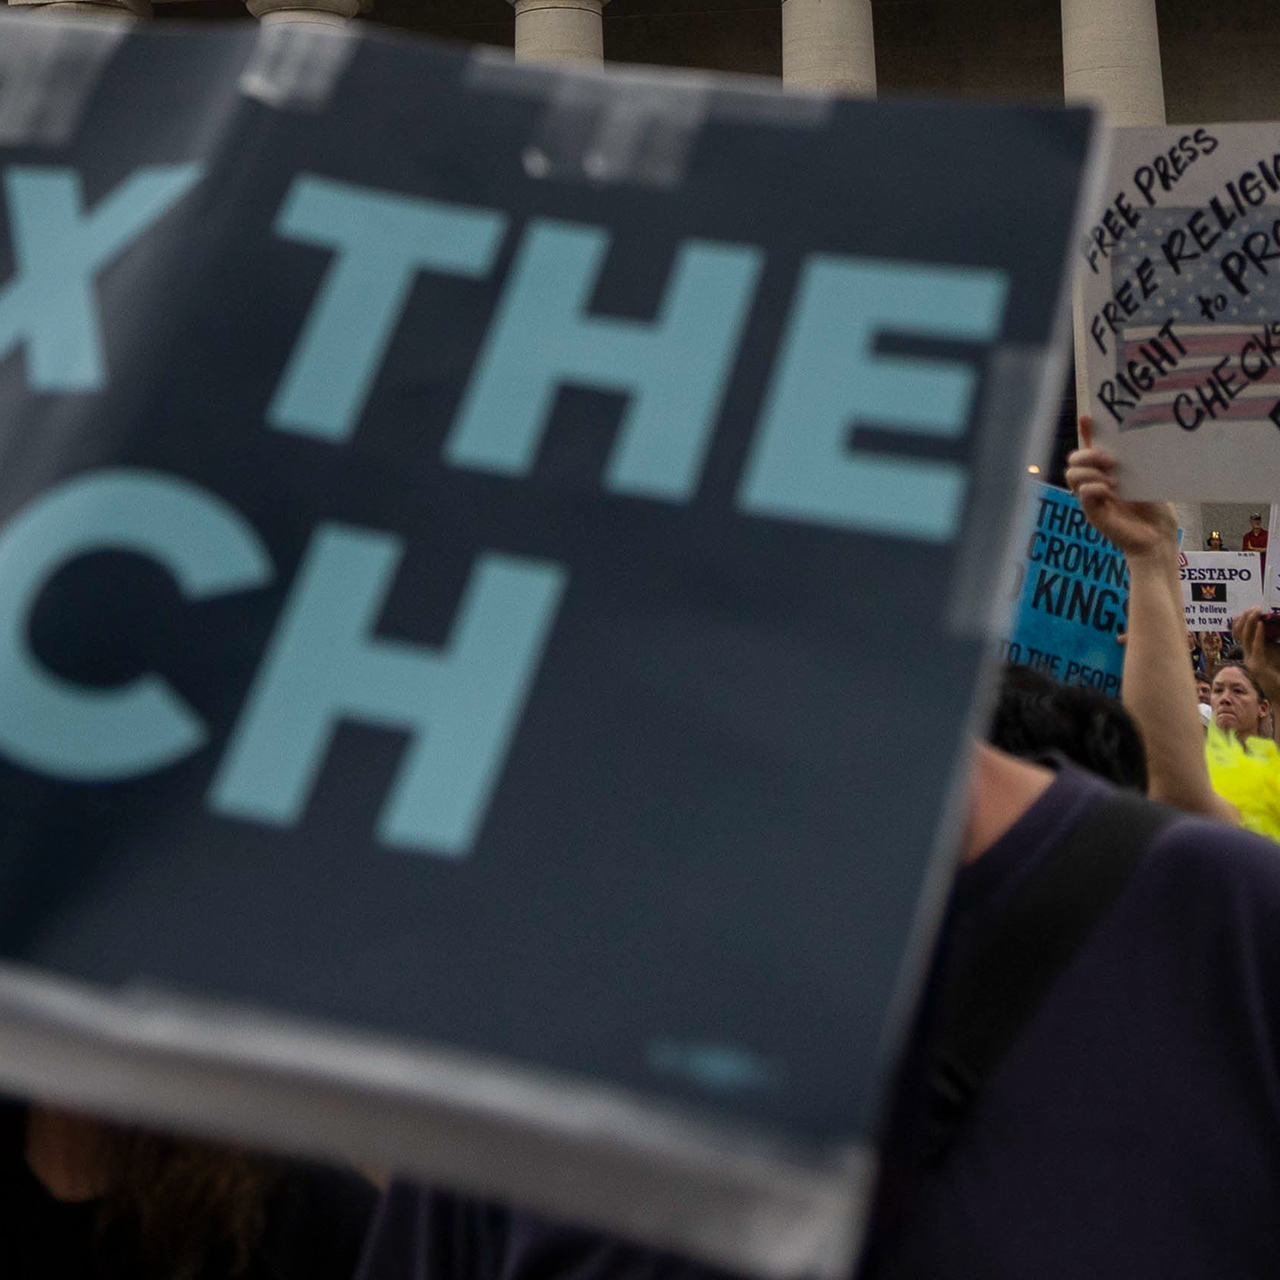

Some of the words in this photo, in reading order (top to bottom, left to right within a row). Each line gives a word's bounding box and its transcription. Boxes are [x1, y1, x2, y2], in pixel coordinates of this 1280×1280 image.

[1084, 192, 1142, 274] FREE
[1133, 128, 1219, 206] PRESS
[1090, 257, 1159, 356] FREE
[267, 172, 1011, 546] THE
[1097, 317, 1188, 424] RIGHT
[1179, 568, 1252, 582] GESTAPO
[1199, 604, 1228, 614] believe
